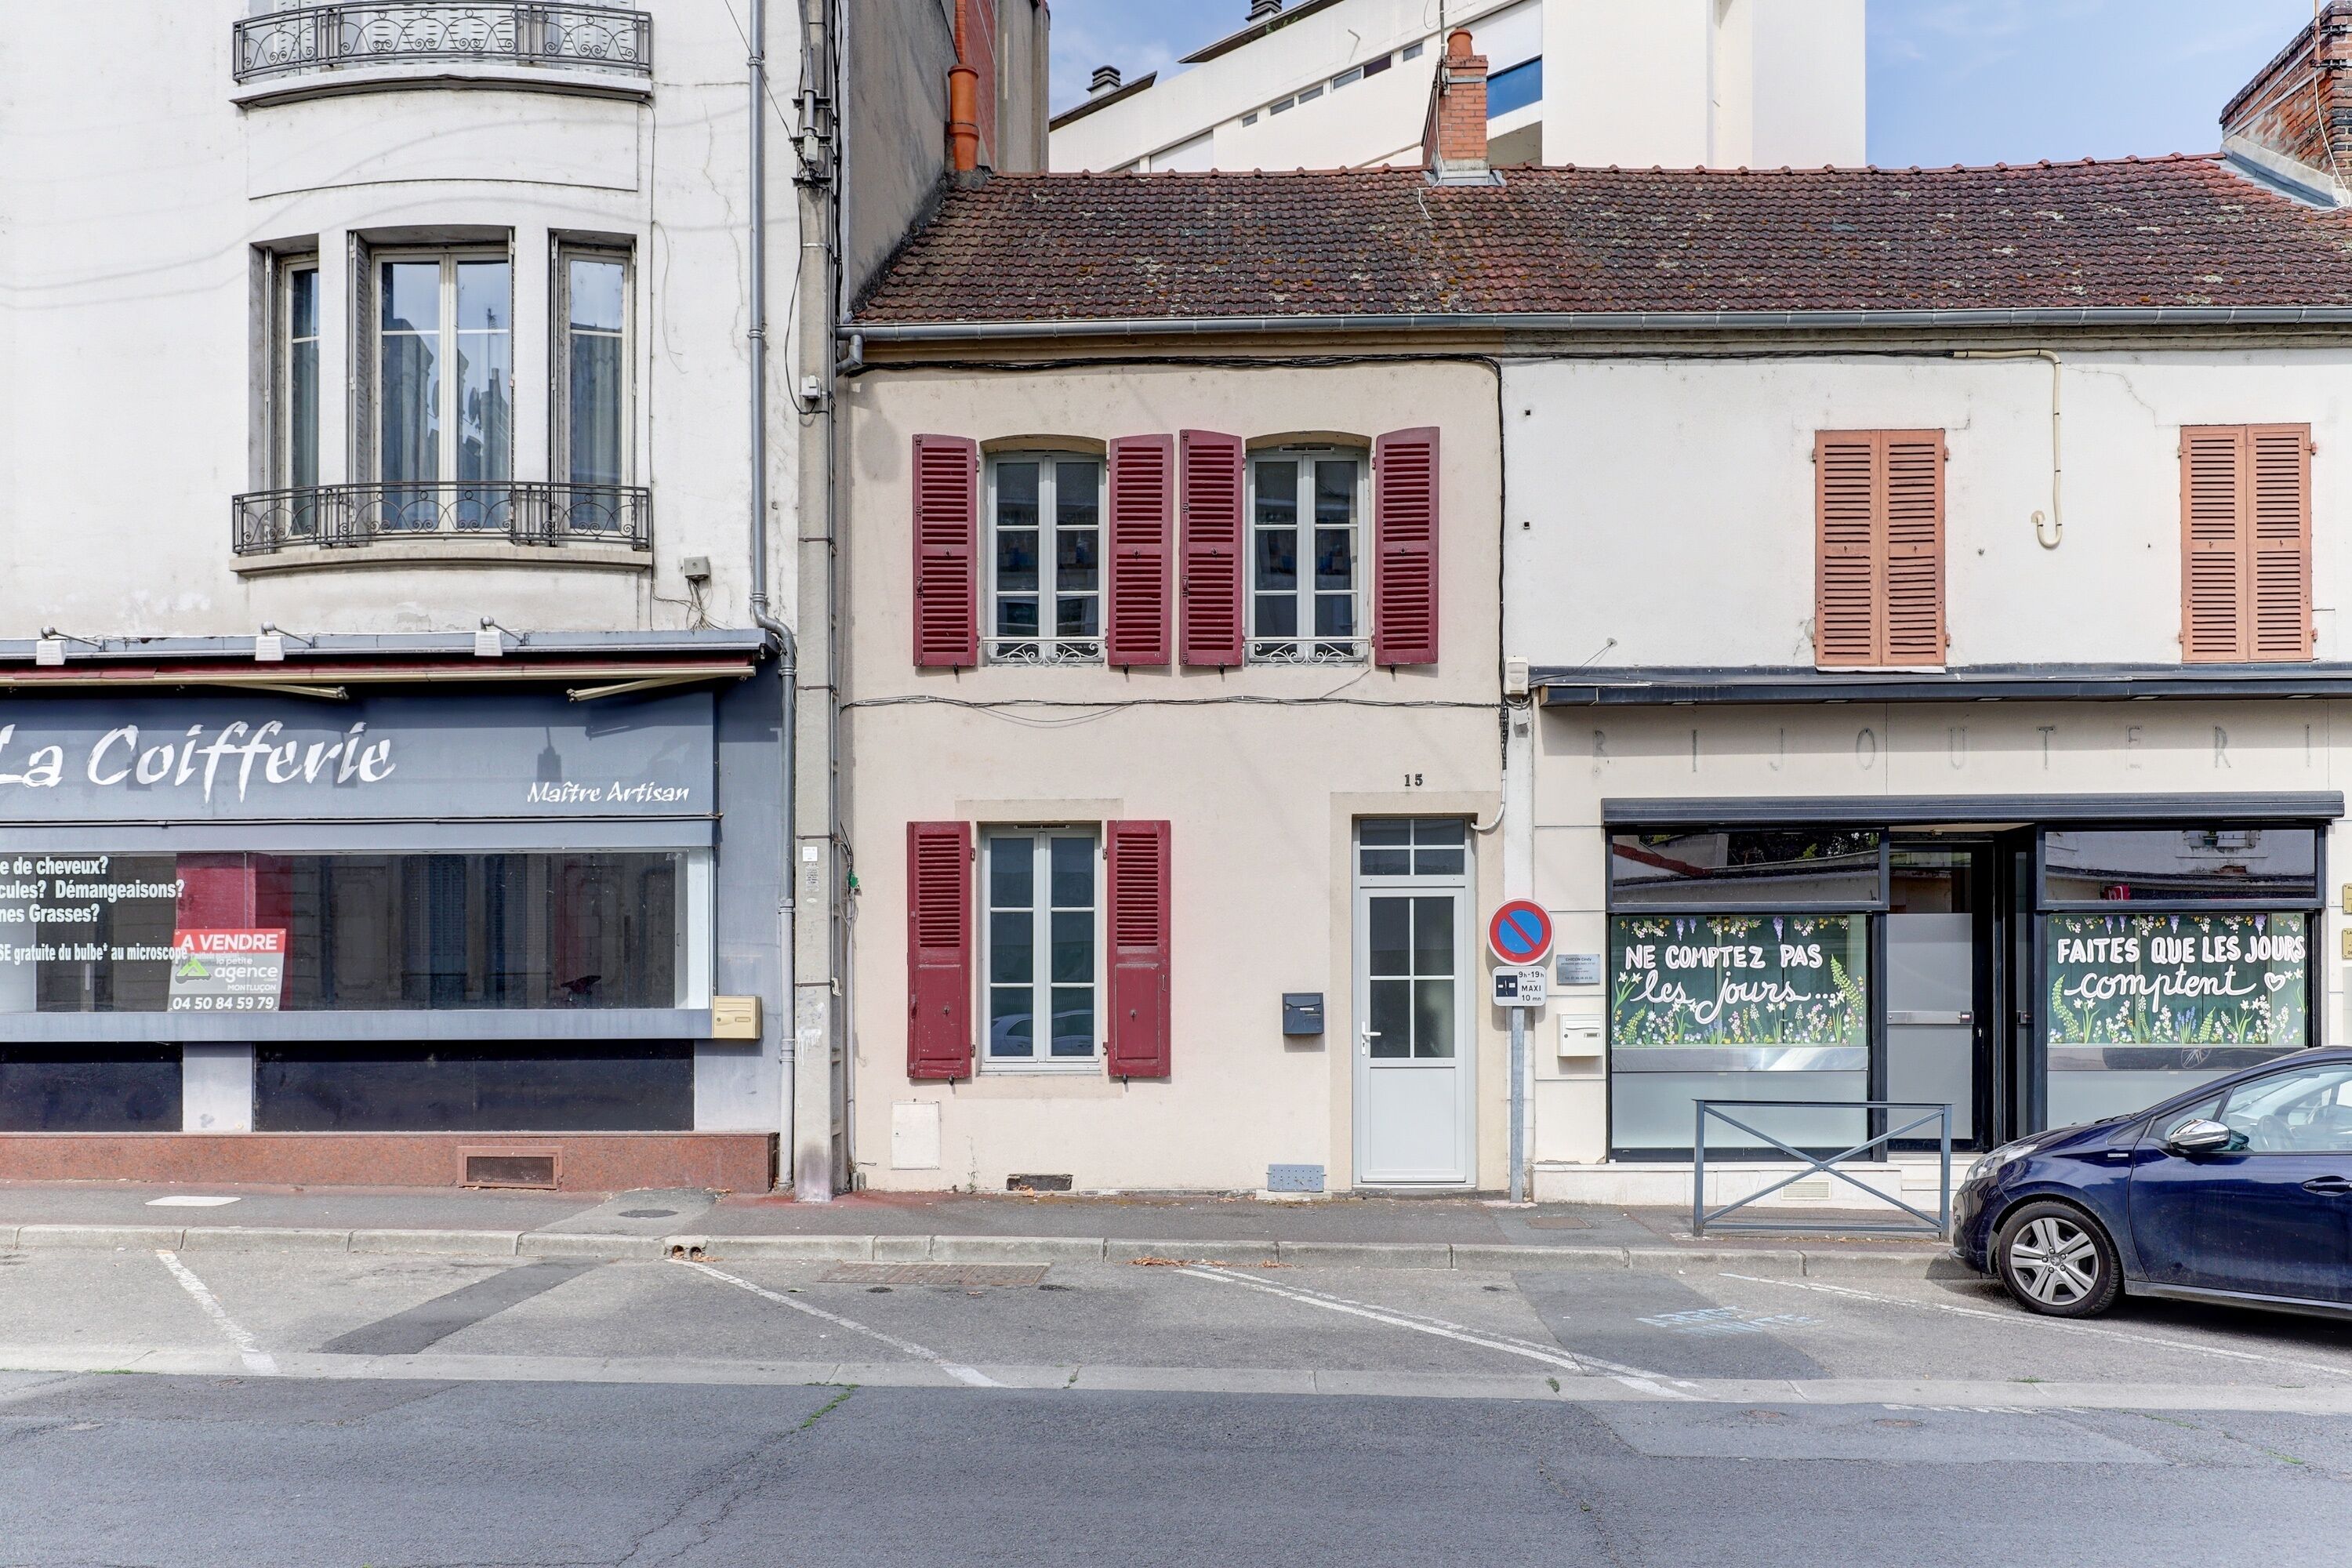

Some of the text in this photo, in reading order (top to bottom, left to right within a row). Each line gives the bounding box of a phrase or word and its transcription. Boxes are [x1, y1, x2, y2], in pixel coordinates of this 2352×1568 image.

[0, 720, 397, 803] La Coifferie
[1404, 773, 1423, 786] 15
[527, 781, 689, 803] Maître Artisan
[13, 856, 32, 875] de
[36, 855, 109, 875] cheveux?
[55, 879, 186, 902] Démangeaisons?
[29, 903, 100, 923] Grasses?
[179, 934, 278, 950] A VENDRE
[2057, 935, 2307, 964] FAITES QUE LES JOURS
[14, 943, 56, 965] gratuite
[58, 943, 71, 961] du
[111, 947, 124, 961] au
[126, 943, 187, 964] microscope
[1625, 943, 1824, 970] NE COMPTEZ PAS
[214, 966, 278, 982] agence
[227, 984, 277, 993] MONTLUÇON
[1630, 969, 1696, 1004] les
[2063, 963, 2256, 1013] comptent
[172, 996, 274, 1010] 04 50 84 59 79
